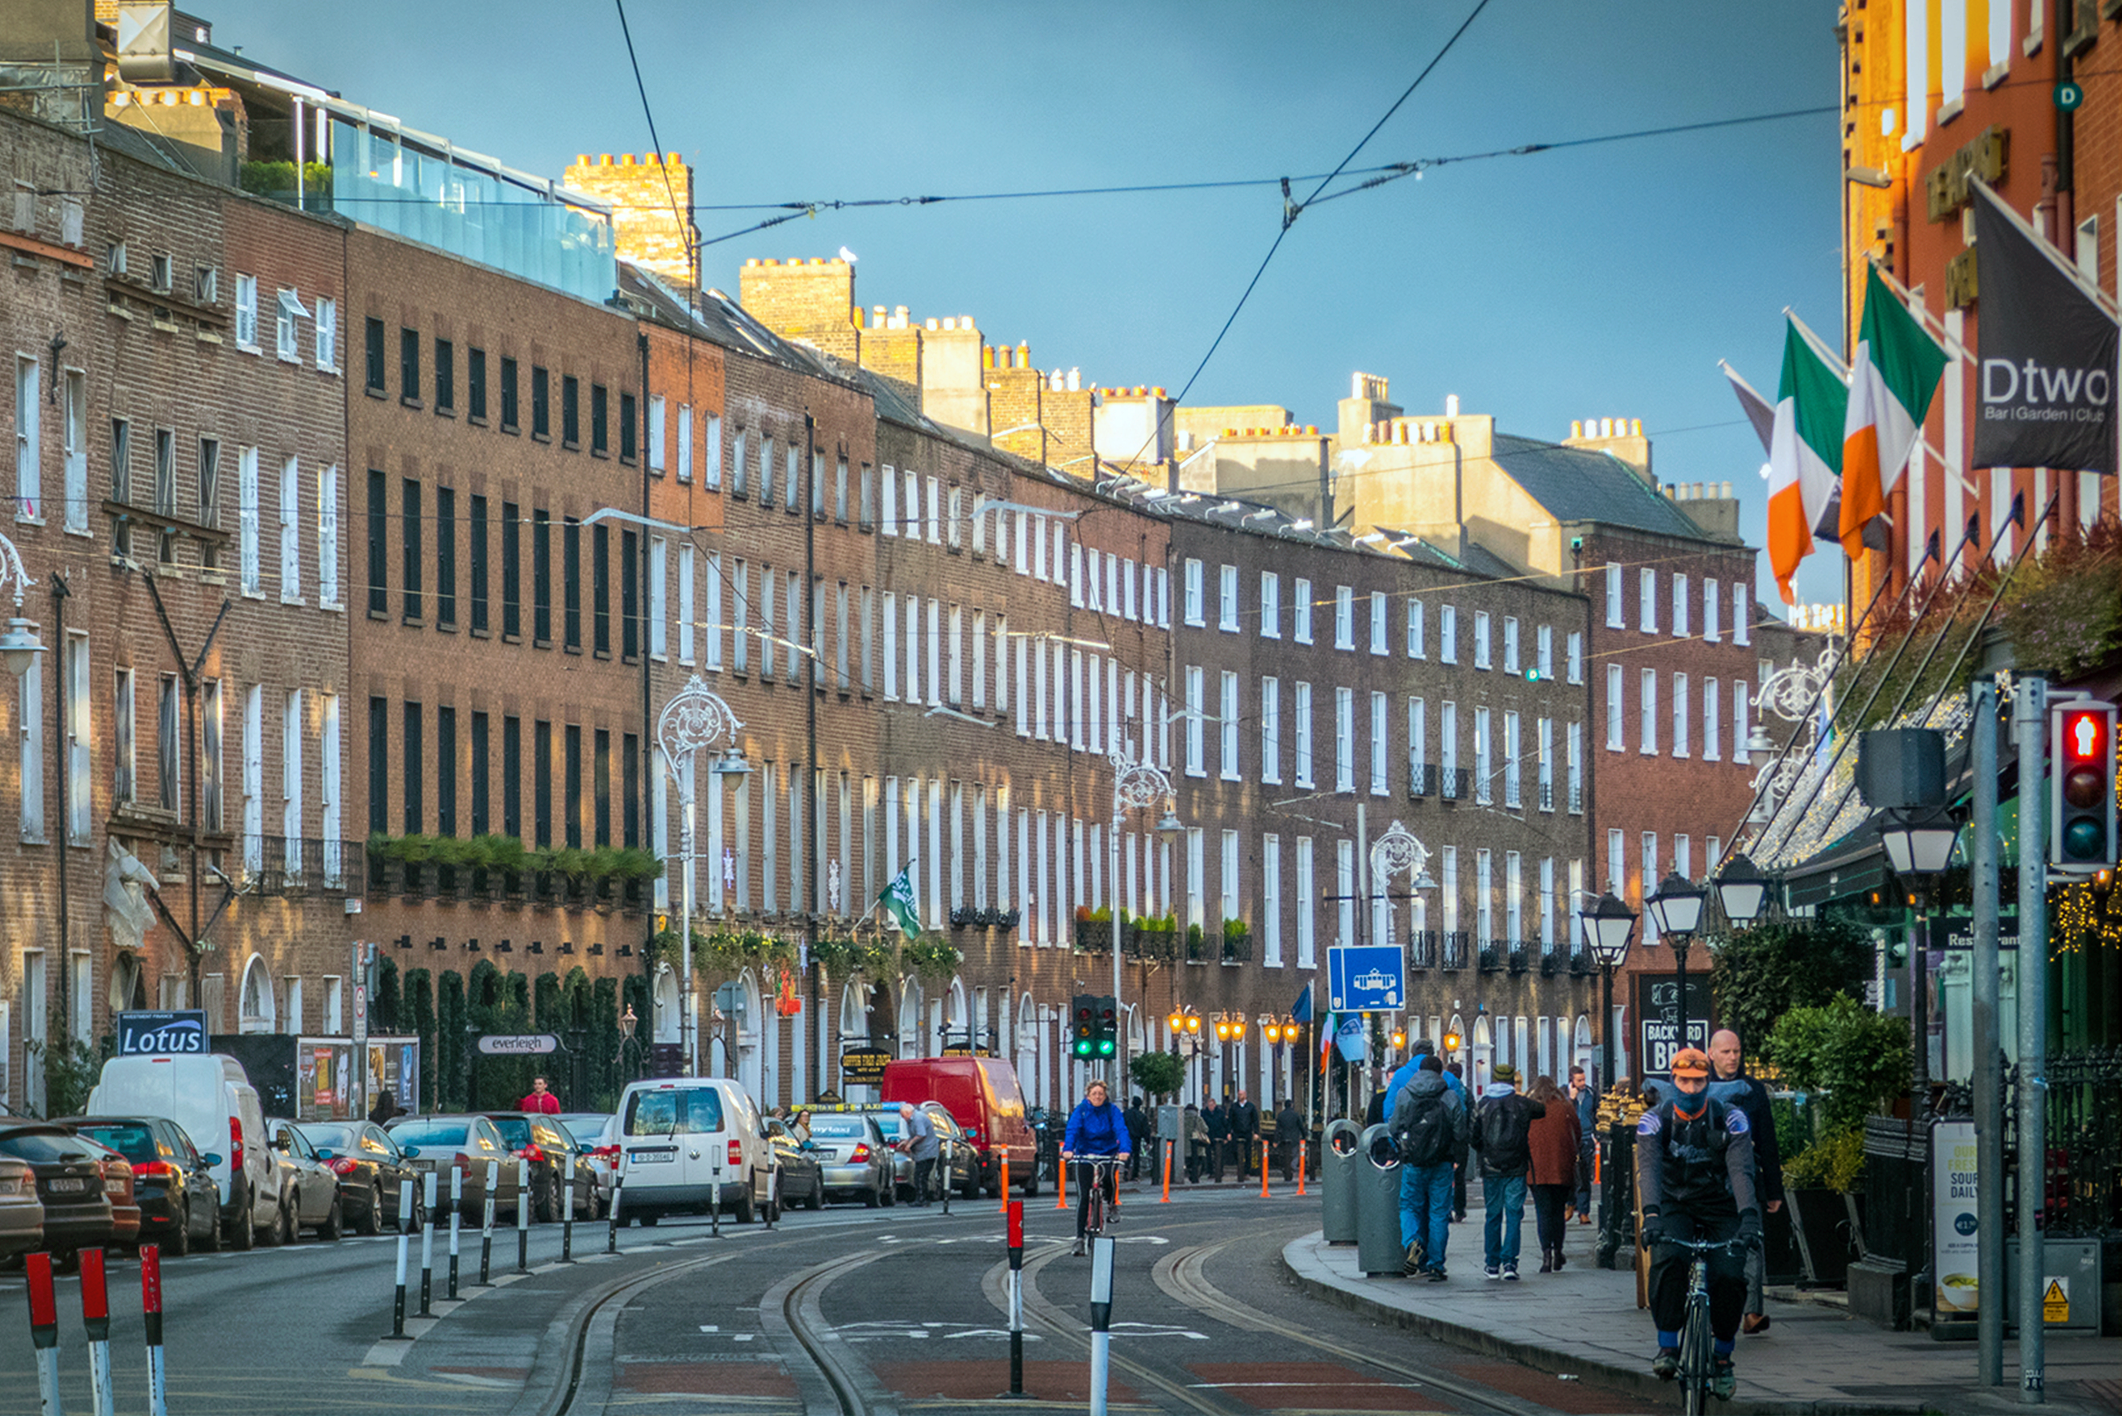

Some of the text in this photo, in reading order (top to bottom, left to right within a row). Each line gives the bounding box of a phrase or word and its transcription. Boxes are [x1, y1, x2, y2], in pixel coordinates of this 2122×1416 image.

[2061, 88, 2075, 105] D
[1983, 358, 2110, 406] Dtwo
[1984, 406, 2106, 423] Bar Garden Club
[123, 1028, 201, 1053] Lotus
[1647, 1025, 1702, 1041] BACKRD
[492, 1035, 542, 1052] everleigh
[1954, 1145, 1977, 1158] OUR
[1947, 1159, 1977, 1171] FRES
